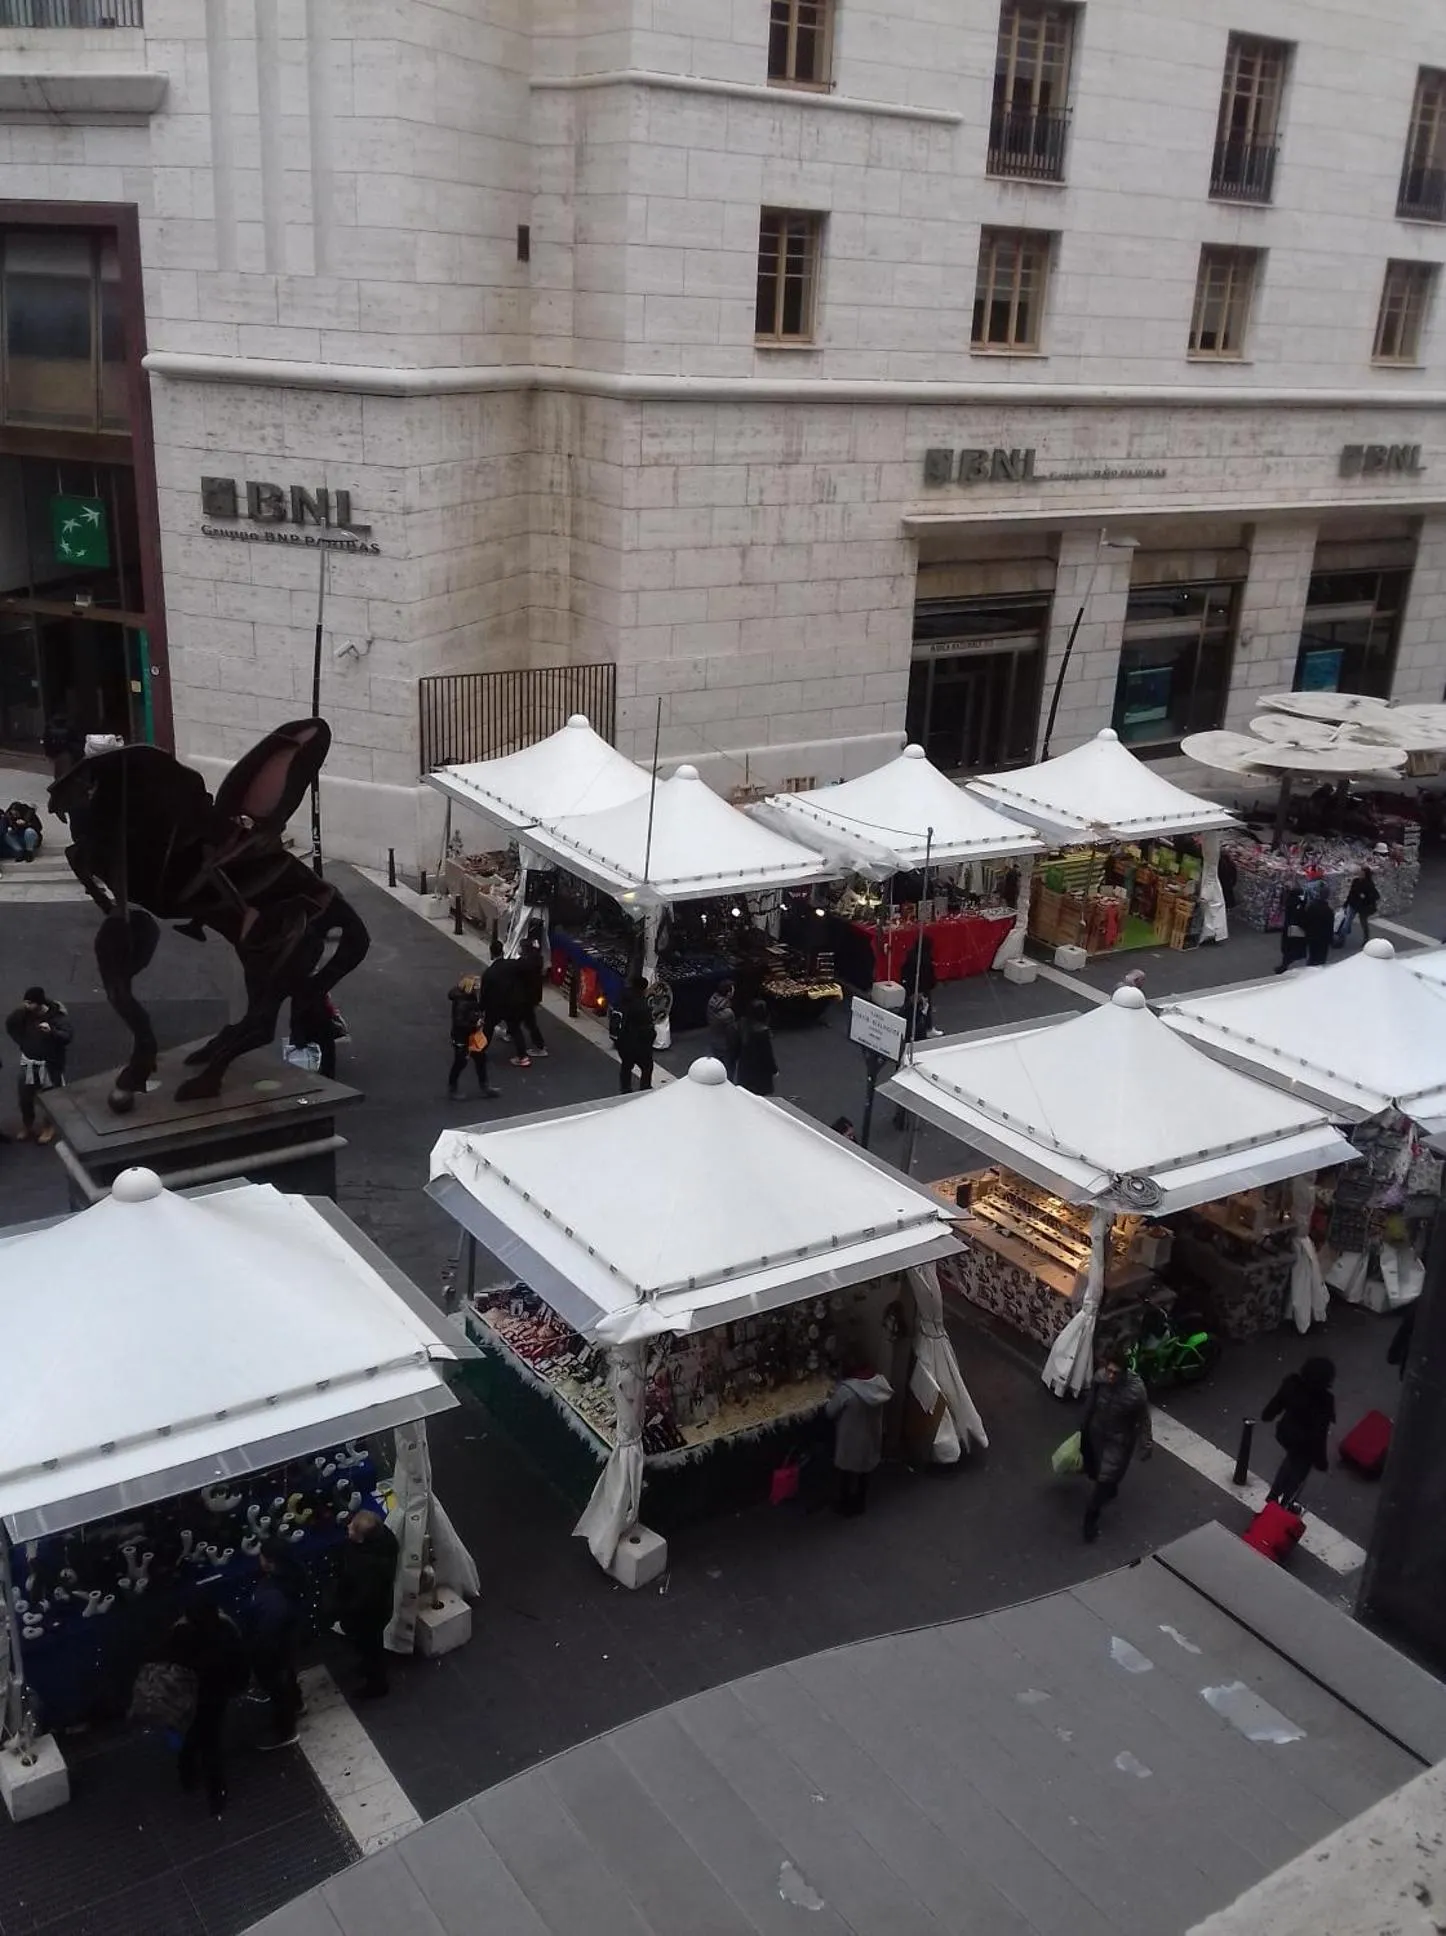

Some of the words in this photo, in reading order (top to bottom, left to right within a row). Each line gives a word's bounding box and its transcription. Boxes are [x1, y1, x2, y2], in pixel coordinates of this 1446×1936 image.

[958, 448, 1046, 482] BNL
[1361, 444, 1428, 477] BNL
[246, 480, 372, 535] BNL
[201, 523, 260, 543] Gruppo
[264, 531, 300, 544] BNP
